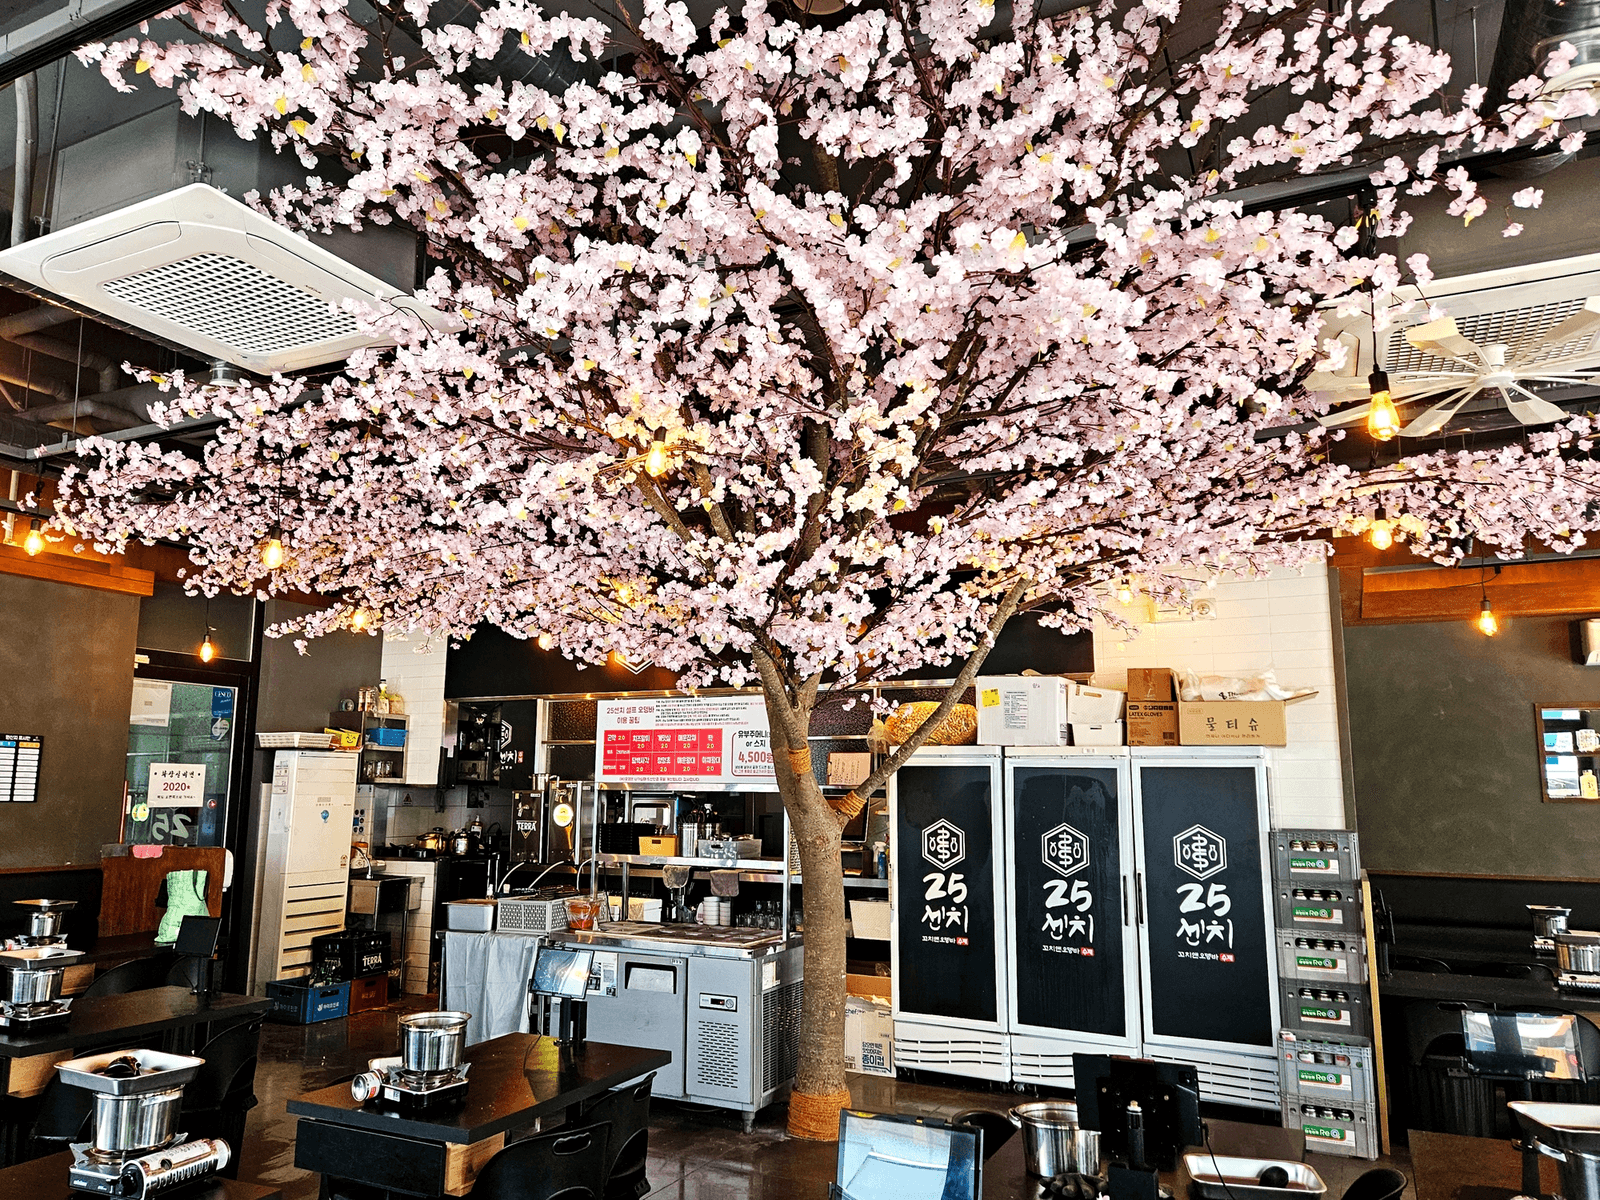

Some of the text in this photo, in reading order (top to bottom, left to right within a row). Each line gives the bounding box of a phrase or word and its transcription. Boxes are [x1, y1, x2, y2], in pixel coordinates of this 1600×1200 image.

[738, 730, 769, 738] 유부주머니
[517, 820, 537, 831] TERRA
[922, 873, 968, 904] 25
[1042, 879, 1093, 912] 25
[1176, 882, 1232, 917] 25
[921, 905, 969, 933] 센치
[1042, 913, 1094, 944] 센치
[1176, 917, 1234, 949] 센치
[362, 953, 382, 967] TERRA
[862, 1054, 884, 1066] 종이컵
